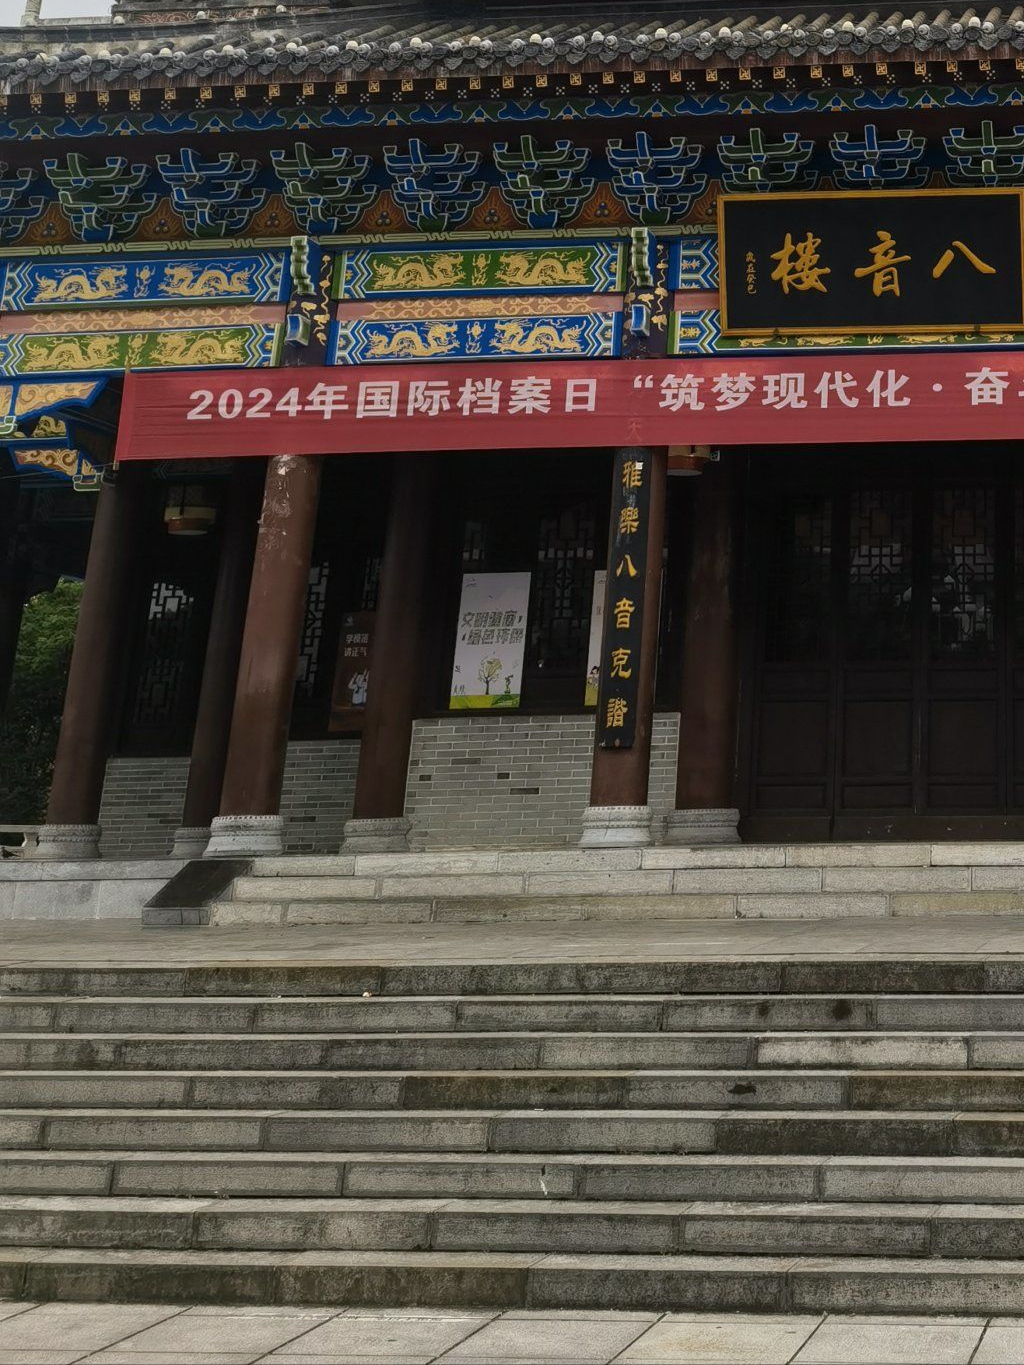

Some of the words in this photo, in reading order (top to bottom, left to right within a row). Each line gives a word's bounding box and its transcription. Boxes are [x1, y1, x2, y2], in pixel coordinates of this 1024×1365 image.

[187, 376, 598, 421] 2024年国际档案日
